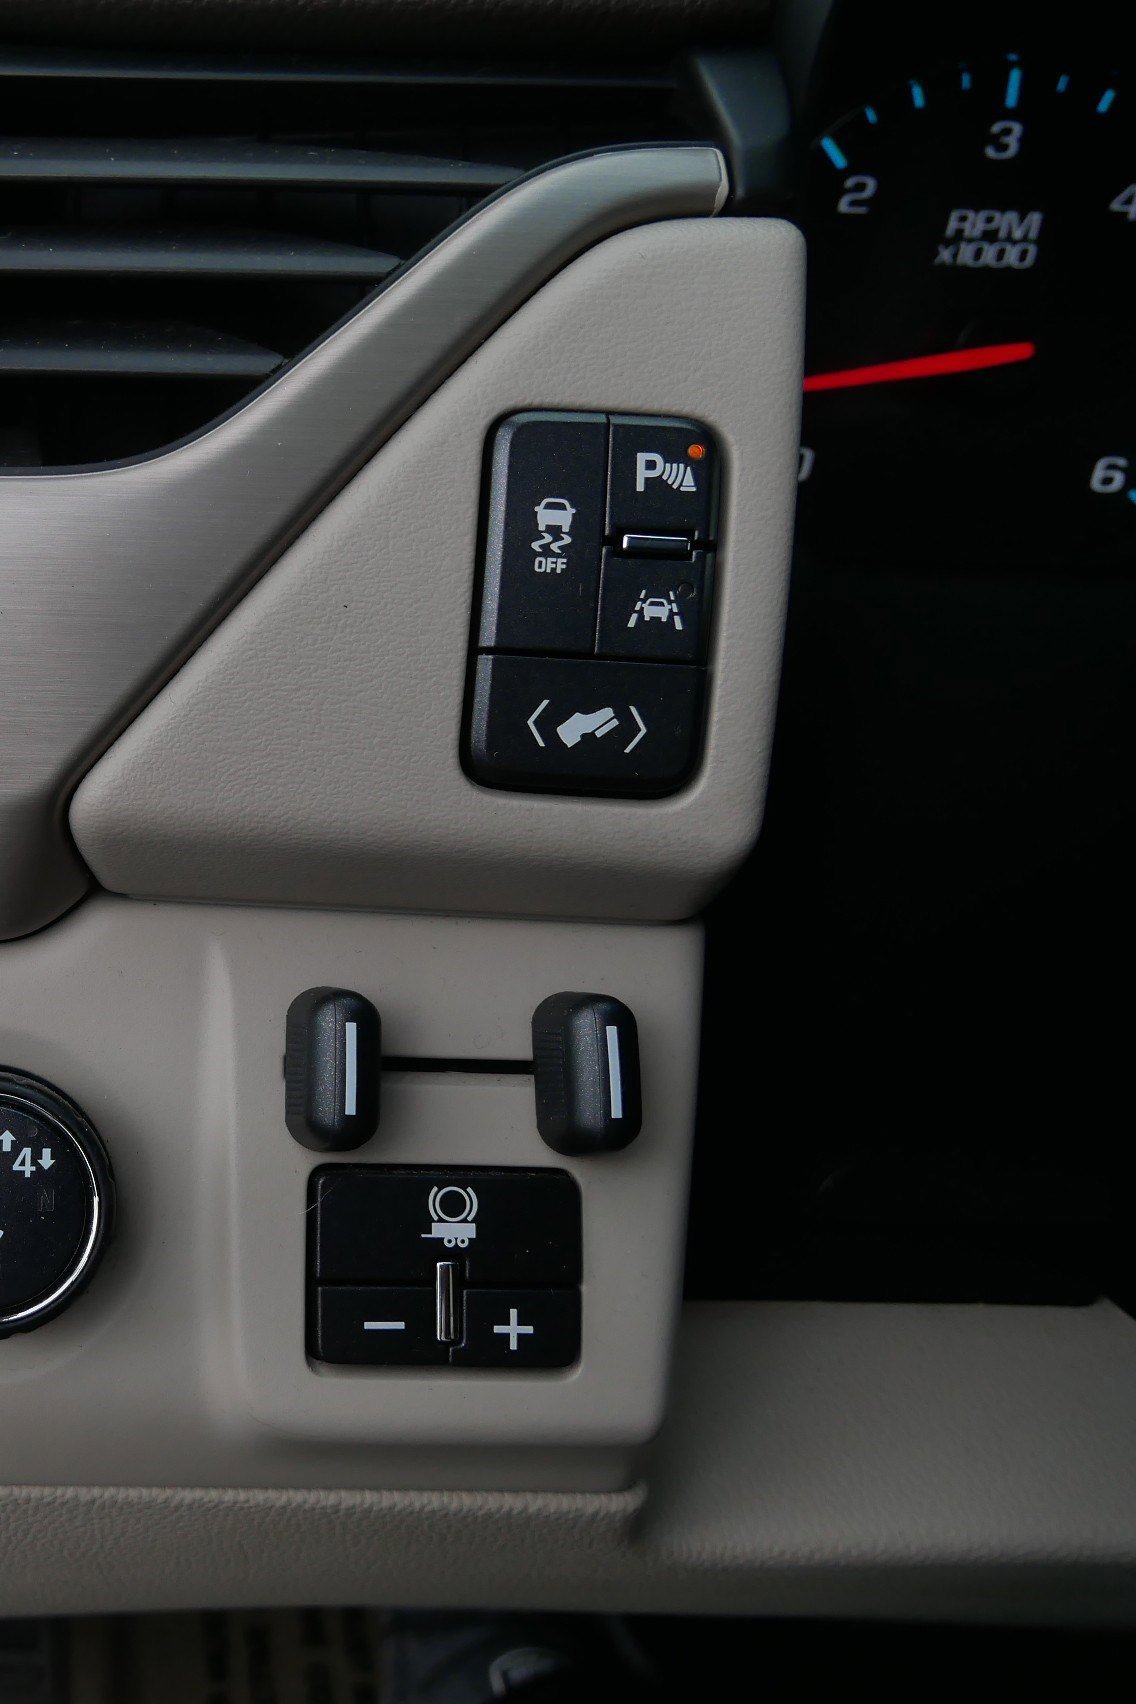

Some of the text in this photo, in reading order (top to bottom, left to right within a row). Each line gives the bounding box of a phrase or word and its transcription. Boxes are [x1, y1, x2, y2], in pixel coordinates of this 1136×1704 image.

[984, 120, 1023, 160] 3
[837, 175, 877, 214] 2
[945, 208, 1043, 241] RPM
[1089, 456, 1129, 494] 6
[533, 556, 568, 574] OFF
[12, 1147, 36, 1178] 4
